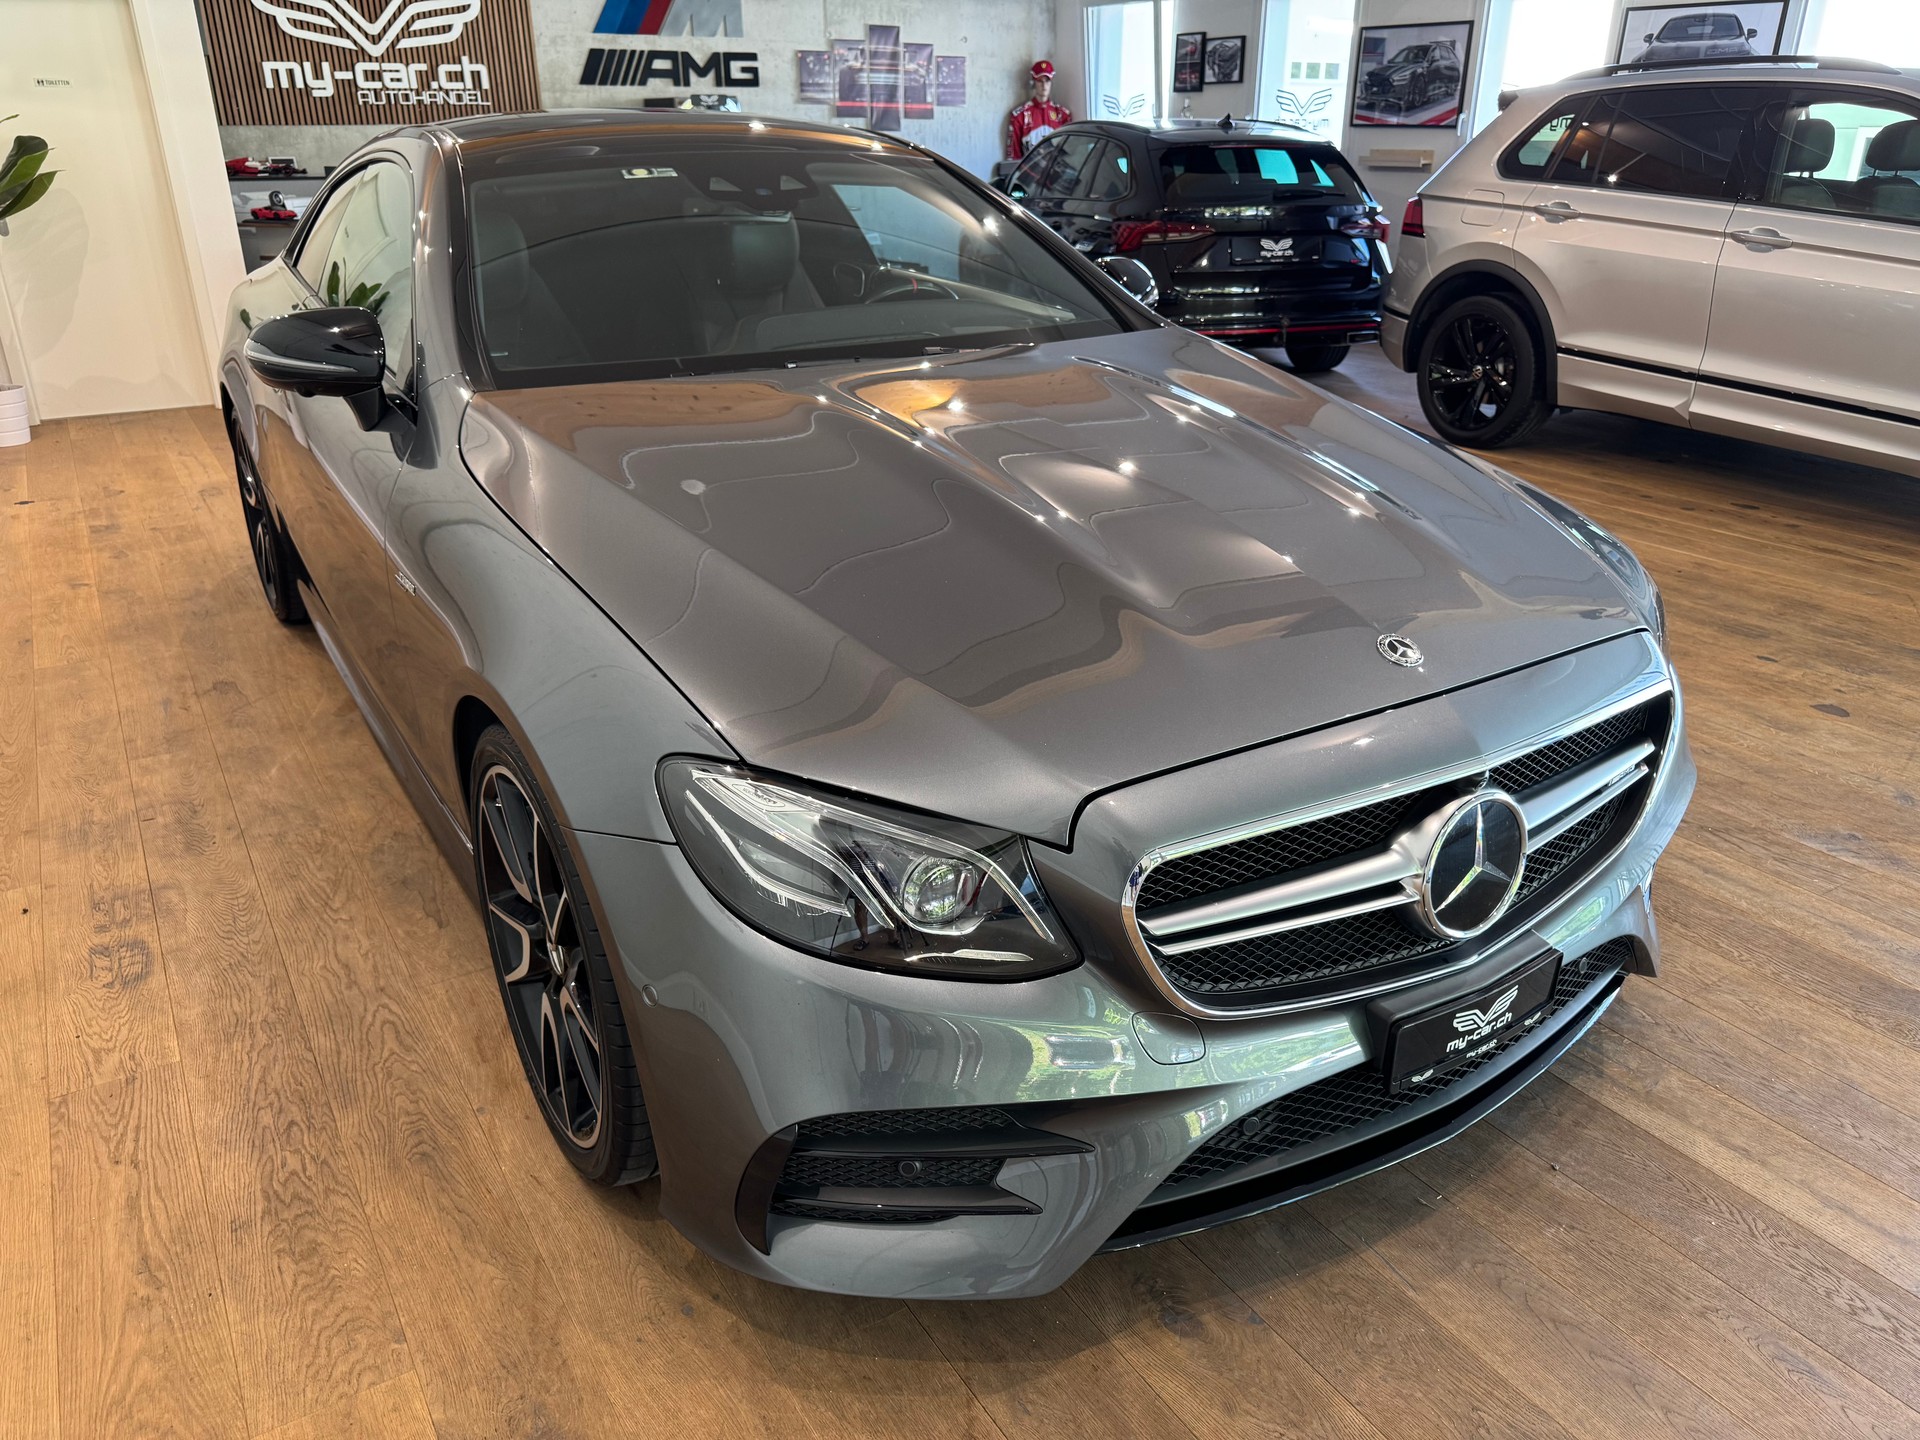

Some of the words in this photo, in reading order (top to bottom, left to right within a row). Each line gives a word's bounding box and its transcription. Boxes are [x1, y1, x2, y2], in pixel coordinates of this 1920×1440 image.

[261, 55, 490, 97] my-car.ch
[357, 90, 491, 106] AUTOHANDEL
[1446, 1012, 1512, 1052] my-car.ch
